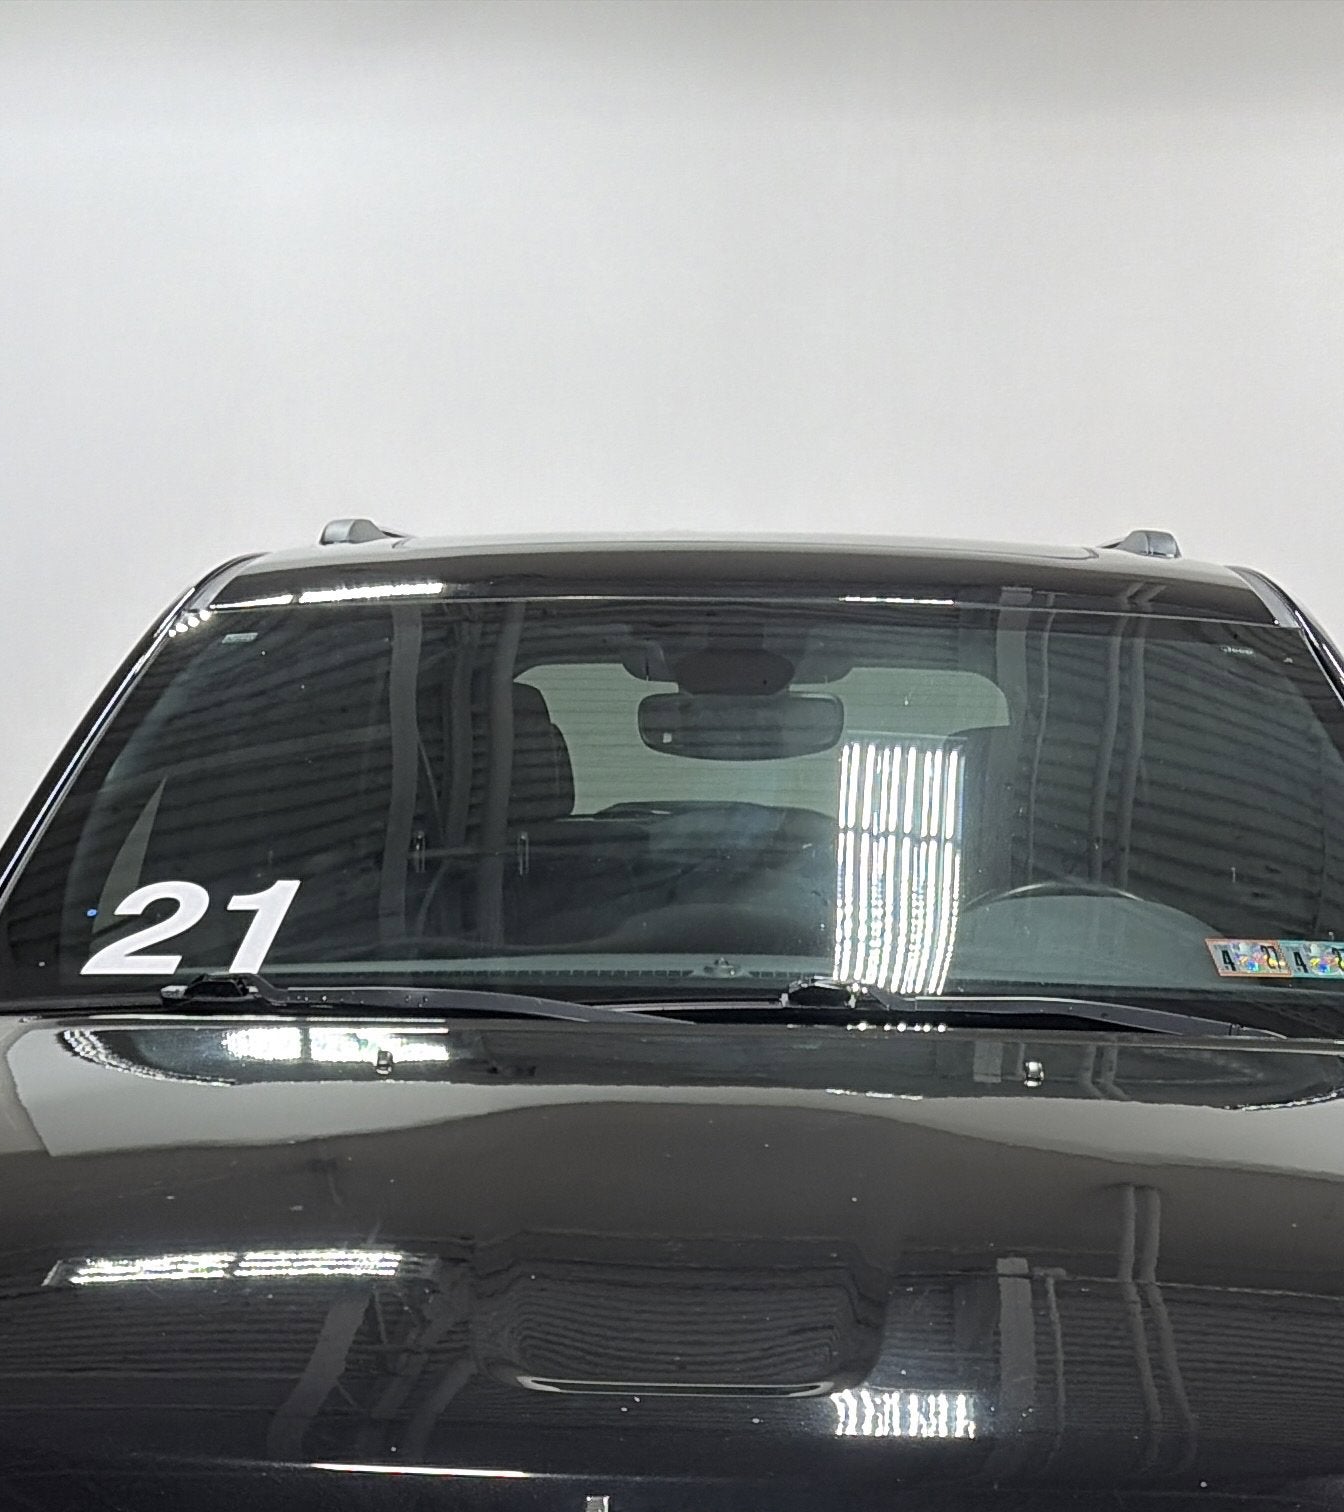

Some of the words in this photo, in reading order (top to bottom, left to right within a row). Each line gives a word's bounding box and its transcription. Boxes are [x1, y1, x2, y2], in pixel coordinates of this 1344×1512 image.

[79, 879, 301, 975] 21
[1221, 949, 1237, 972] 4
[1293, 951, 1309, 974] 4
